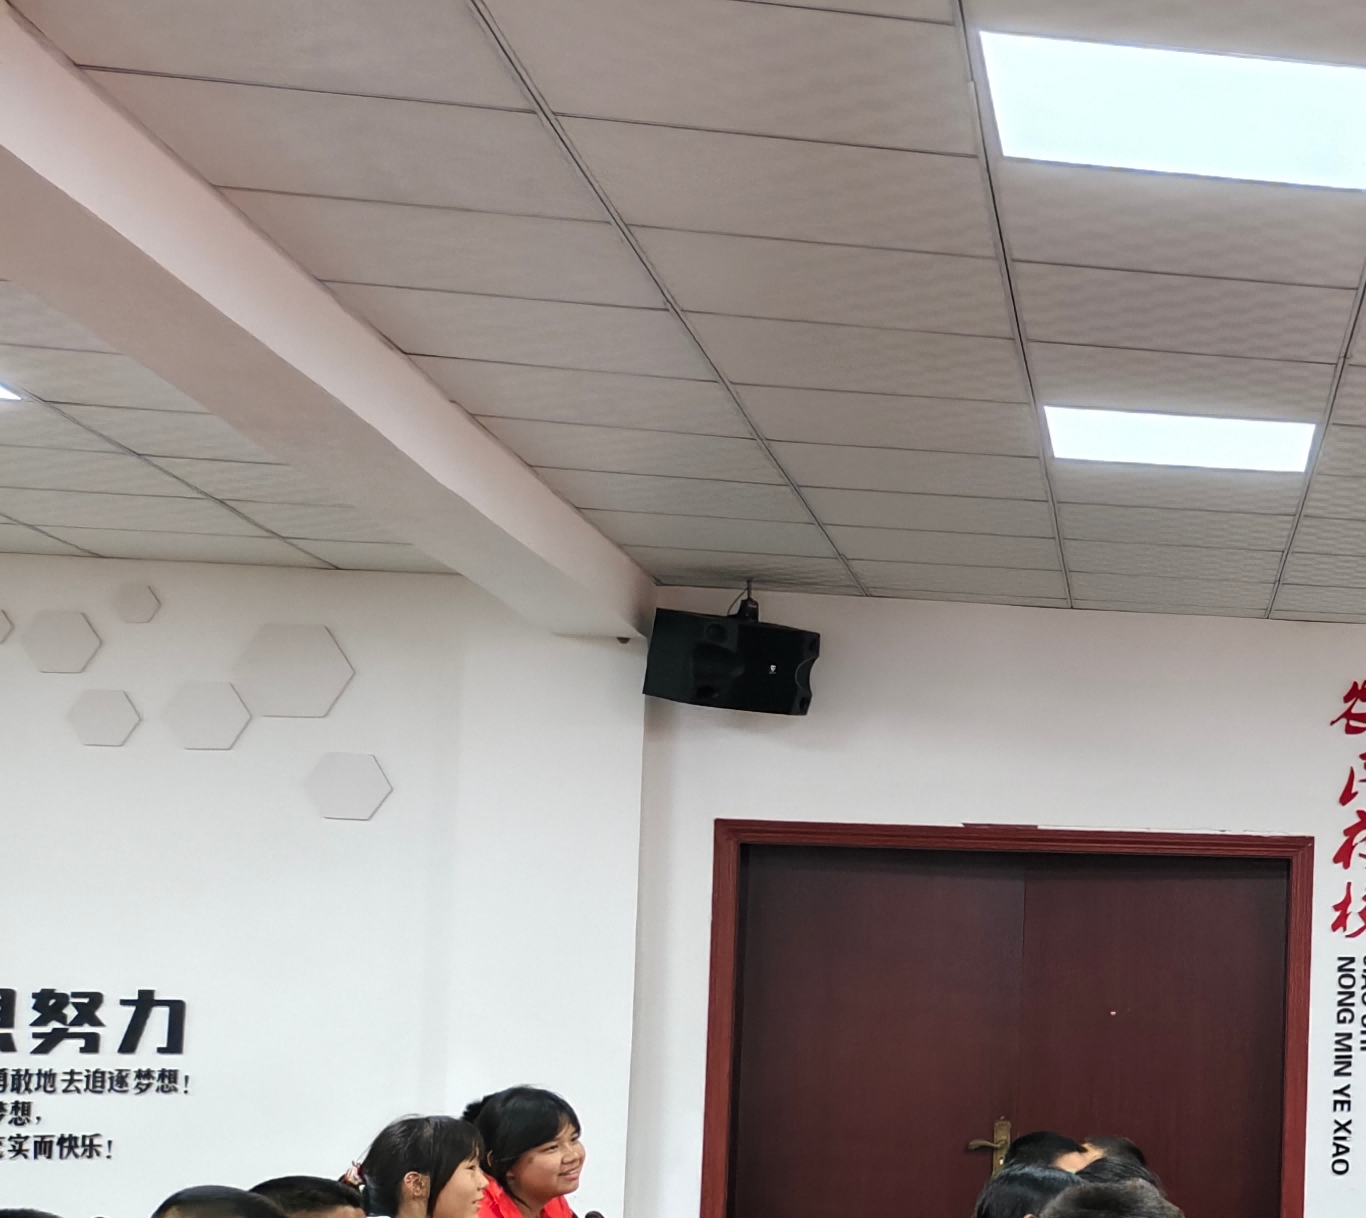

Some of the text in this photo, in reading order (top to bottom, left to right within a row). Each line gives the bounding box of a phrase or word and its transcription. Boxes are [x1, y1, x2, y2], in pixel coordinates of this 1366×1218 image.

[0, 988, 186, 1055] 努力
[1331, 956, 1356, 1176] NONG MIN YE XIAO
[0, 1133, 113, 1161] 实而快乐！
